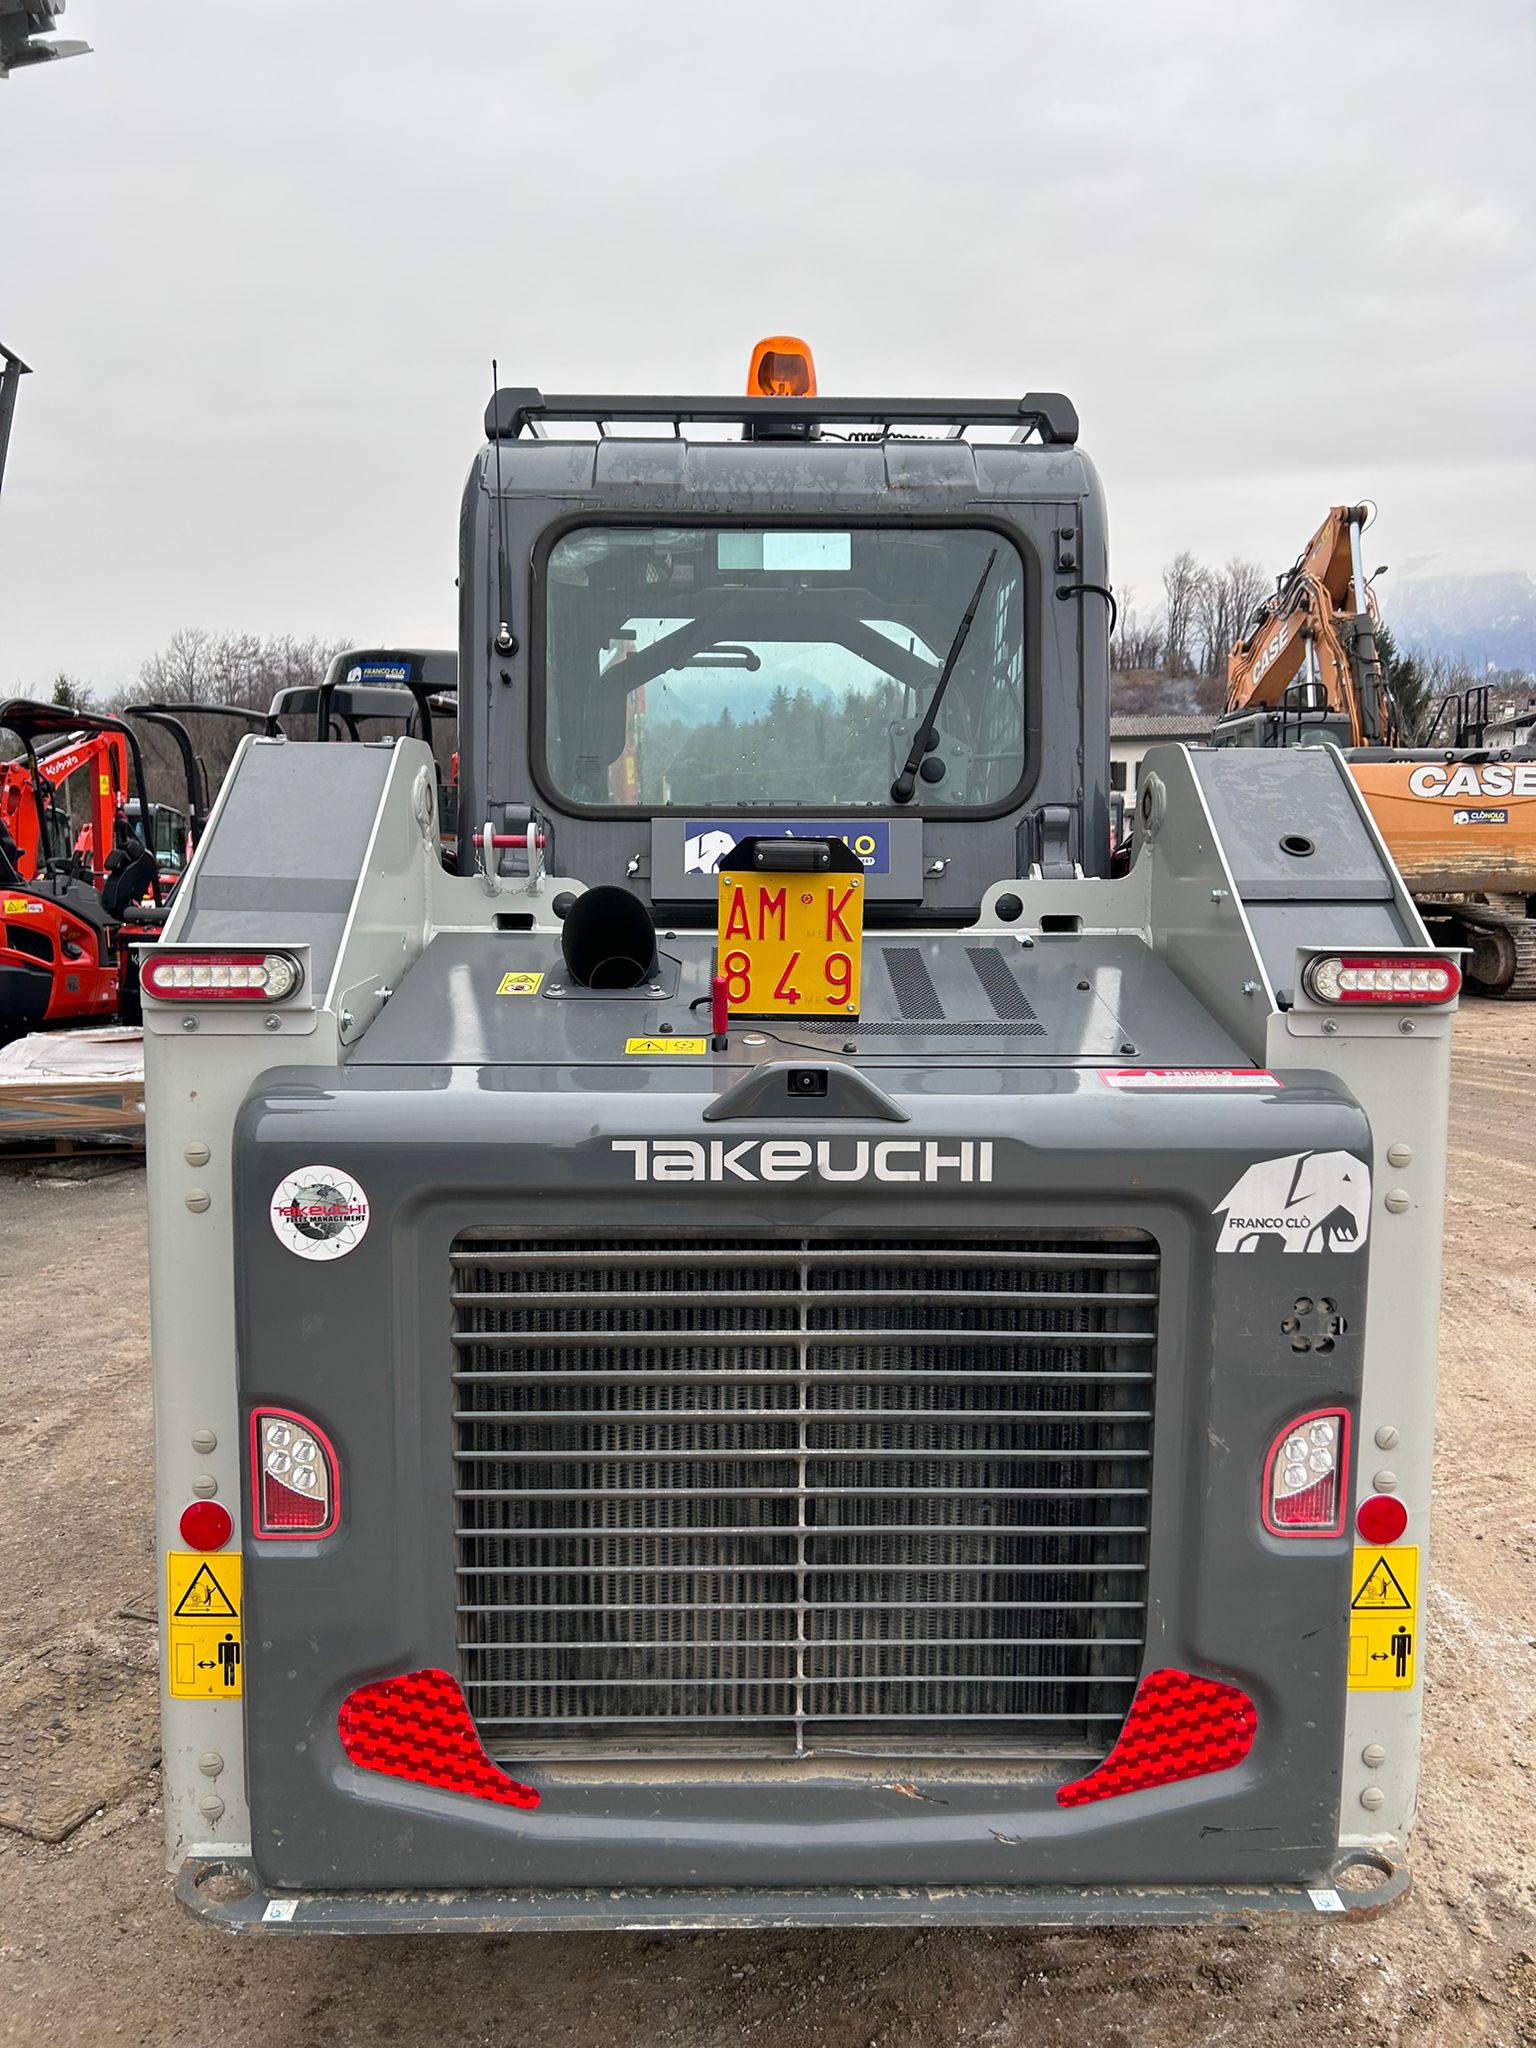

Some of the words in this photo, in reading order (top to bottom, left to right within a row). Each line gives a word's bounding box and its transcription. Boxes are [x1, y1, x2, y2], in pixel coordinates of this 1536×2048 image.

[1252, 622, 1289, 685] CASE
[45, 755, 79, 775] Kubota
[1408, 764, 1536, 798] CASE
[725, 885, 786, 940] AM
[826, 886, 855, 941] K
[1229, 1218, 1283, 1228] FRANCO
[1285, 1215, 1311, 1228] CLÒ
